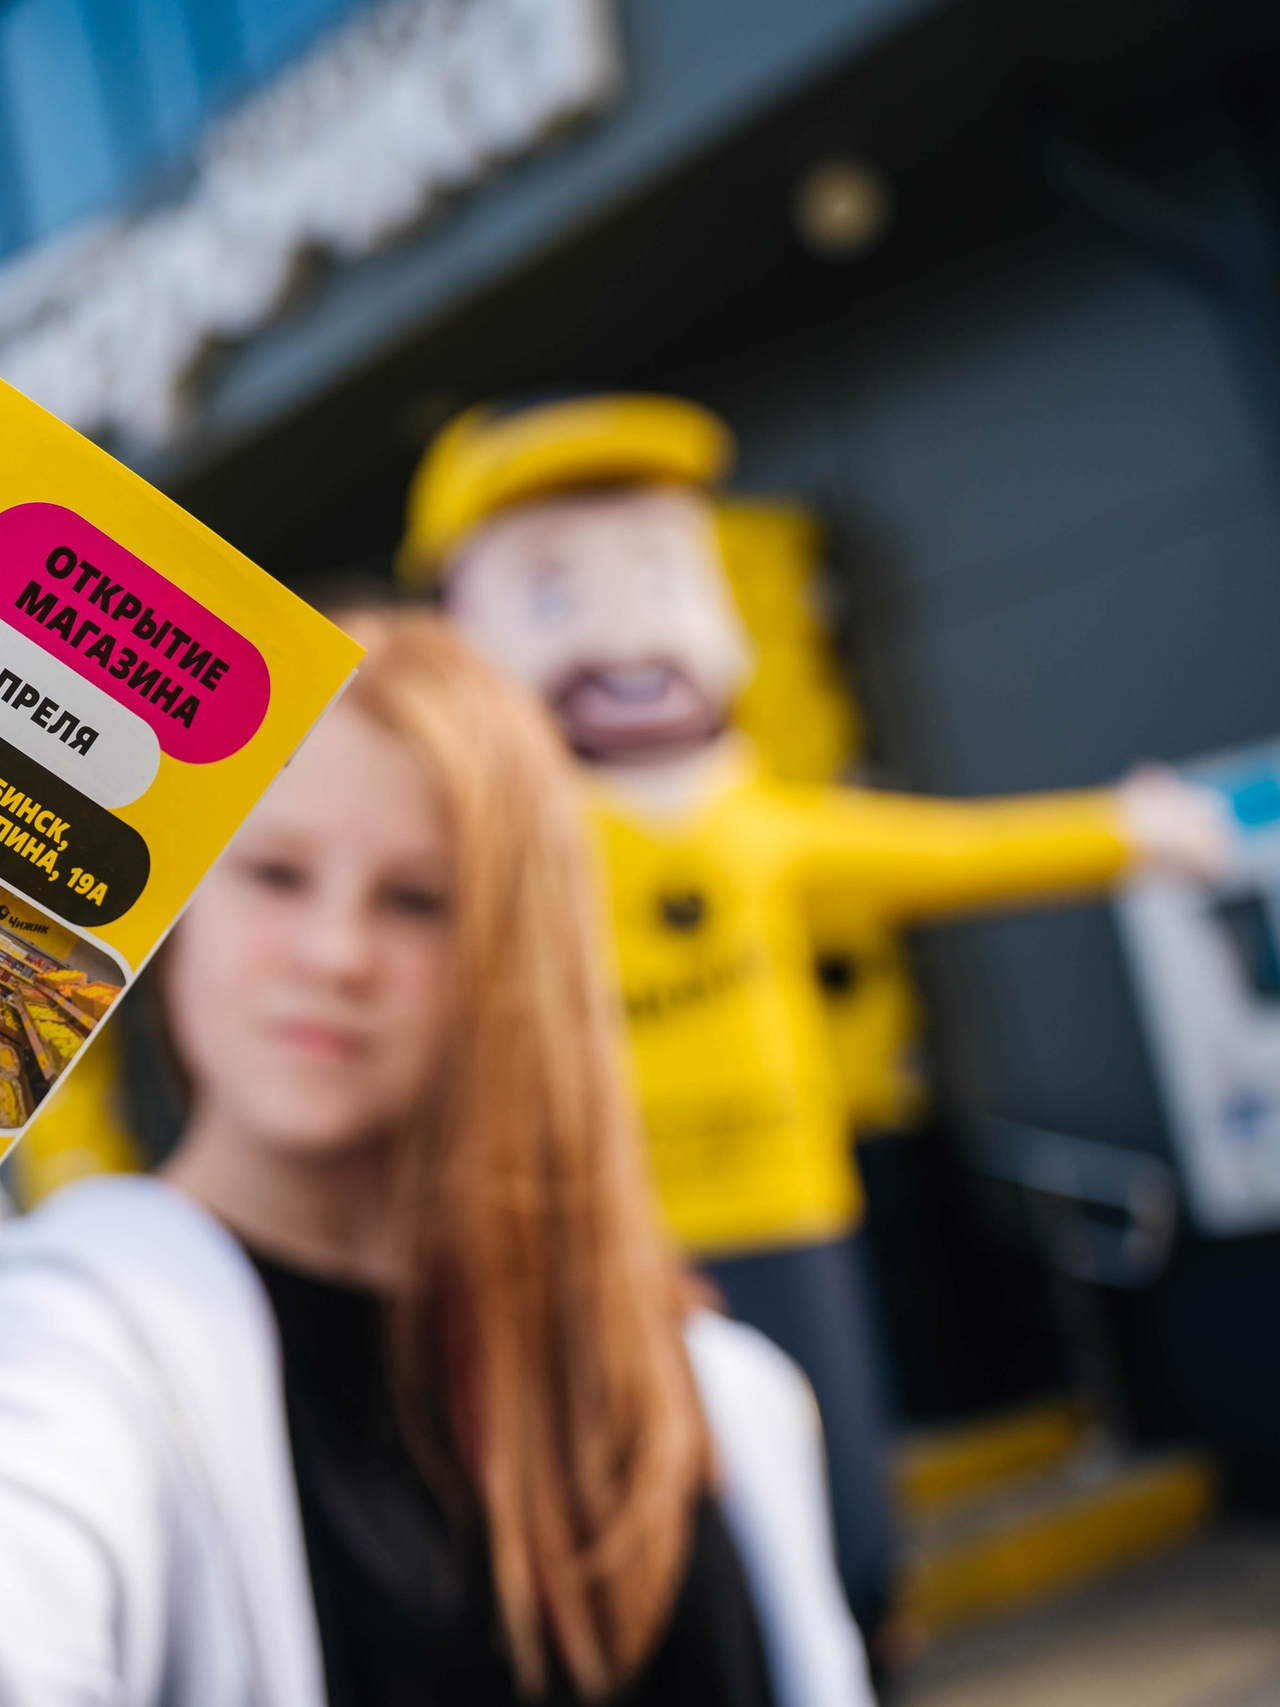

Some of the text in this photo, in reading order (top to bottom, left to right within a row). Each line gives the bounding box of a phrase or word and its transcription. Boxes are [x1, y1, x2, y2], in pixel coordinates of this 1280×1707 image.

[14, 580, 200, 729] МАГАЗИНА
[45, 546, 230, 691] ОТКРЫТИЕ
[66, 867, 108, 907] 19А
